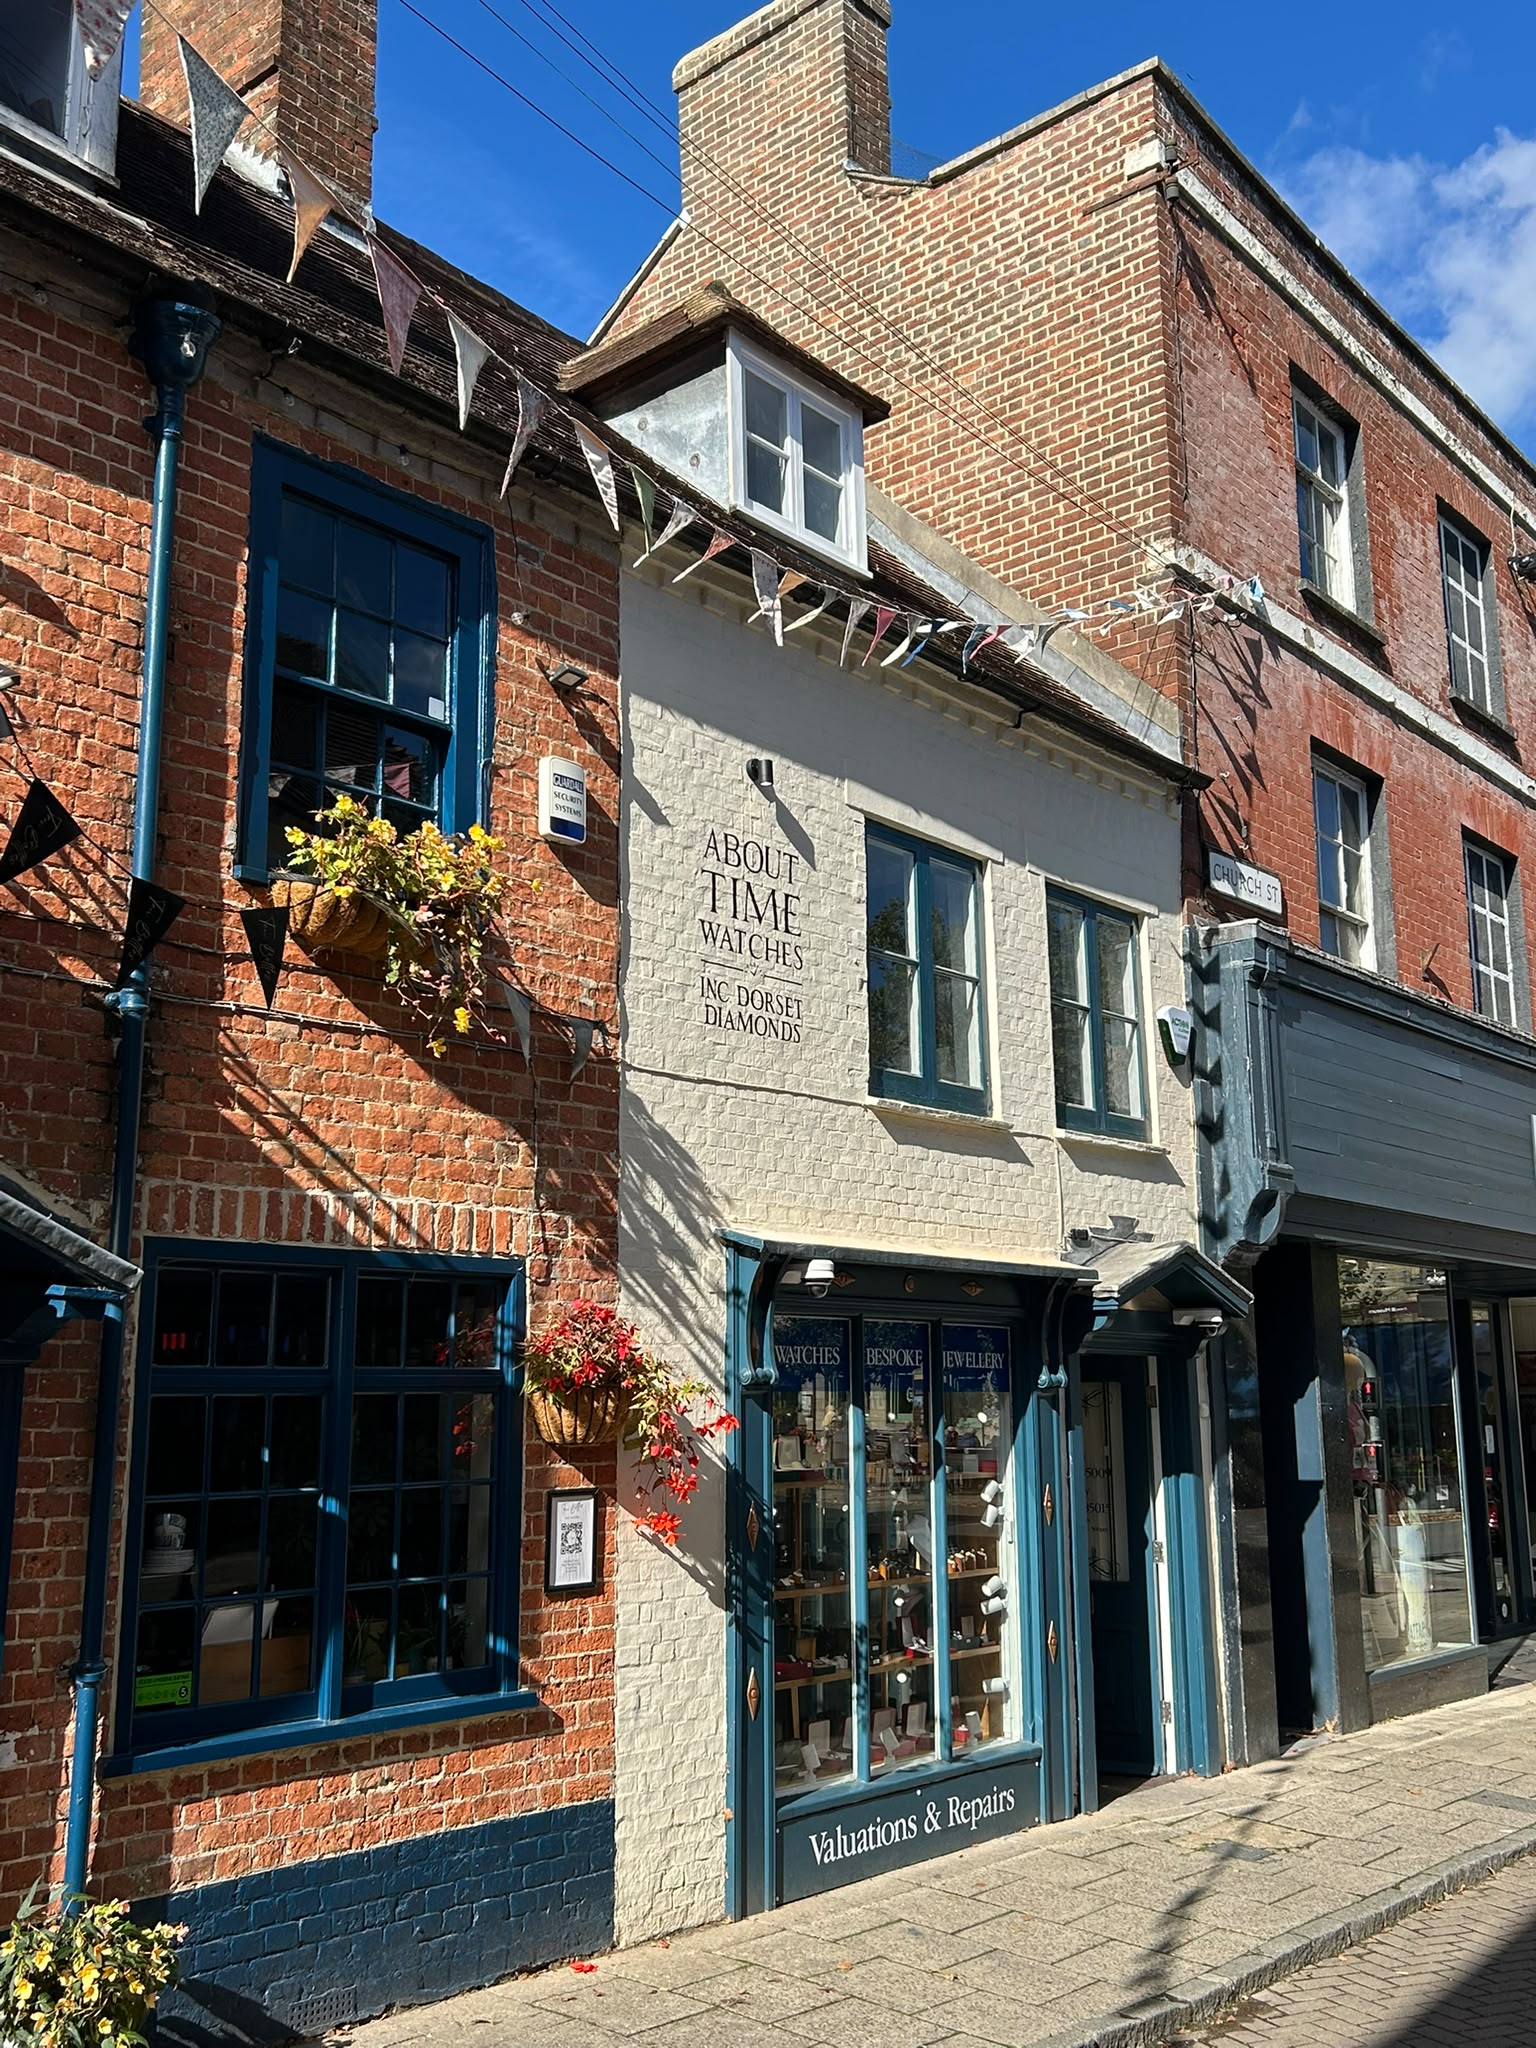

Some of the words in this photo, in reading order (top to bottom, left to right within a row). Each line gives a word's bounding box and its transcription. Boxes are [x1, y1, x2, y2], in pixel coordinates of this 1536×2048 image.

[554, 790, 583, 806] SECURITY
[554, 803, 582, 818] SYSTEMS
[703, 827, 800, 885] ABOUT
[1213, 863, 1262, 897] CHURCH
[701, 868, 801, 937] TIME
[698, 918, 803, 970] WATCHES
[737, 985, 803, 1020] DORSET
[704, 1004, 801, 1044] DIAMONDS
[774, 1344, 841, 1366] WATCHES
[865, 1348, 924, 1367] BESPOKE
[942, 1350, 1005, 1369] JEWELLERY
[181, 1687, 187, 1697] 5
[808, 1813, 918, 1867] Valuations
[923, 1801, 942, 1835] &
[947, 1785, 1016, 1831] Repairs
